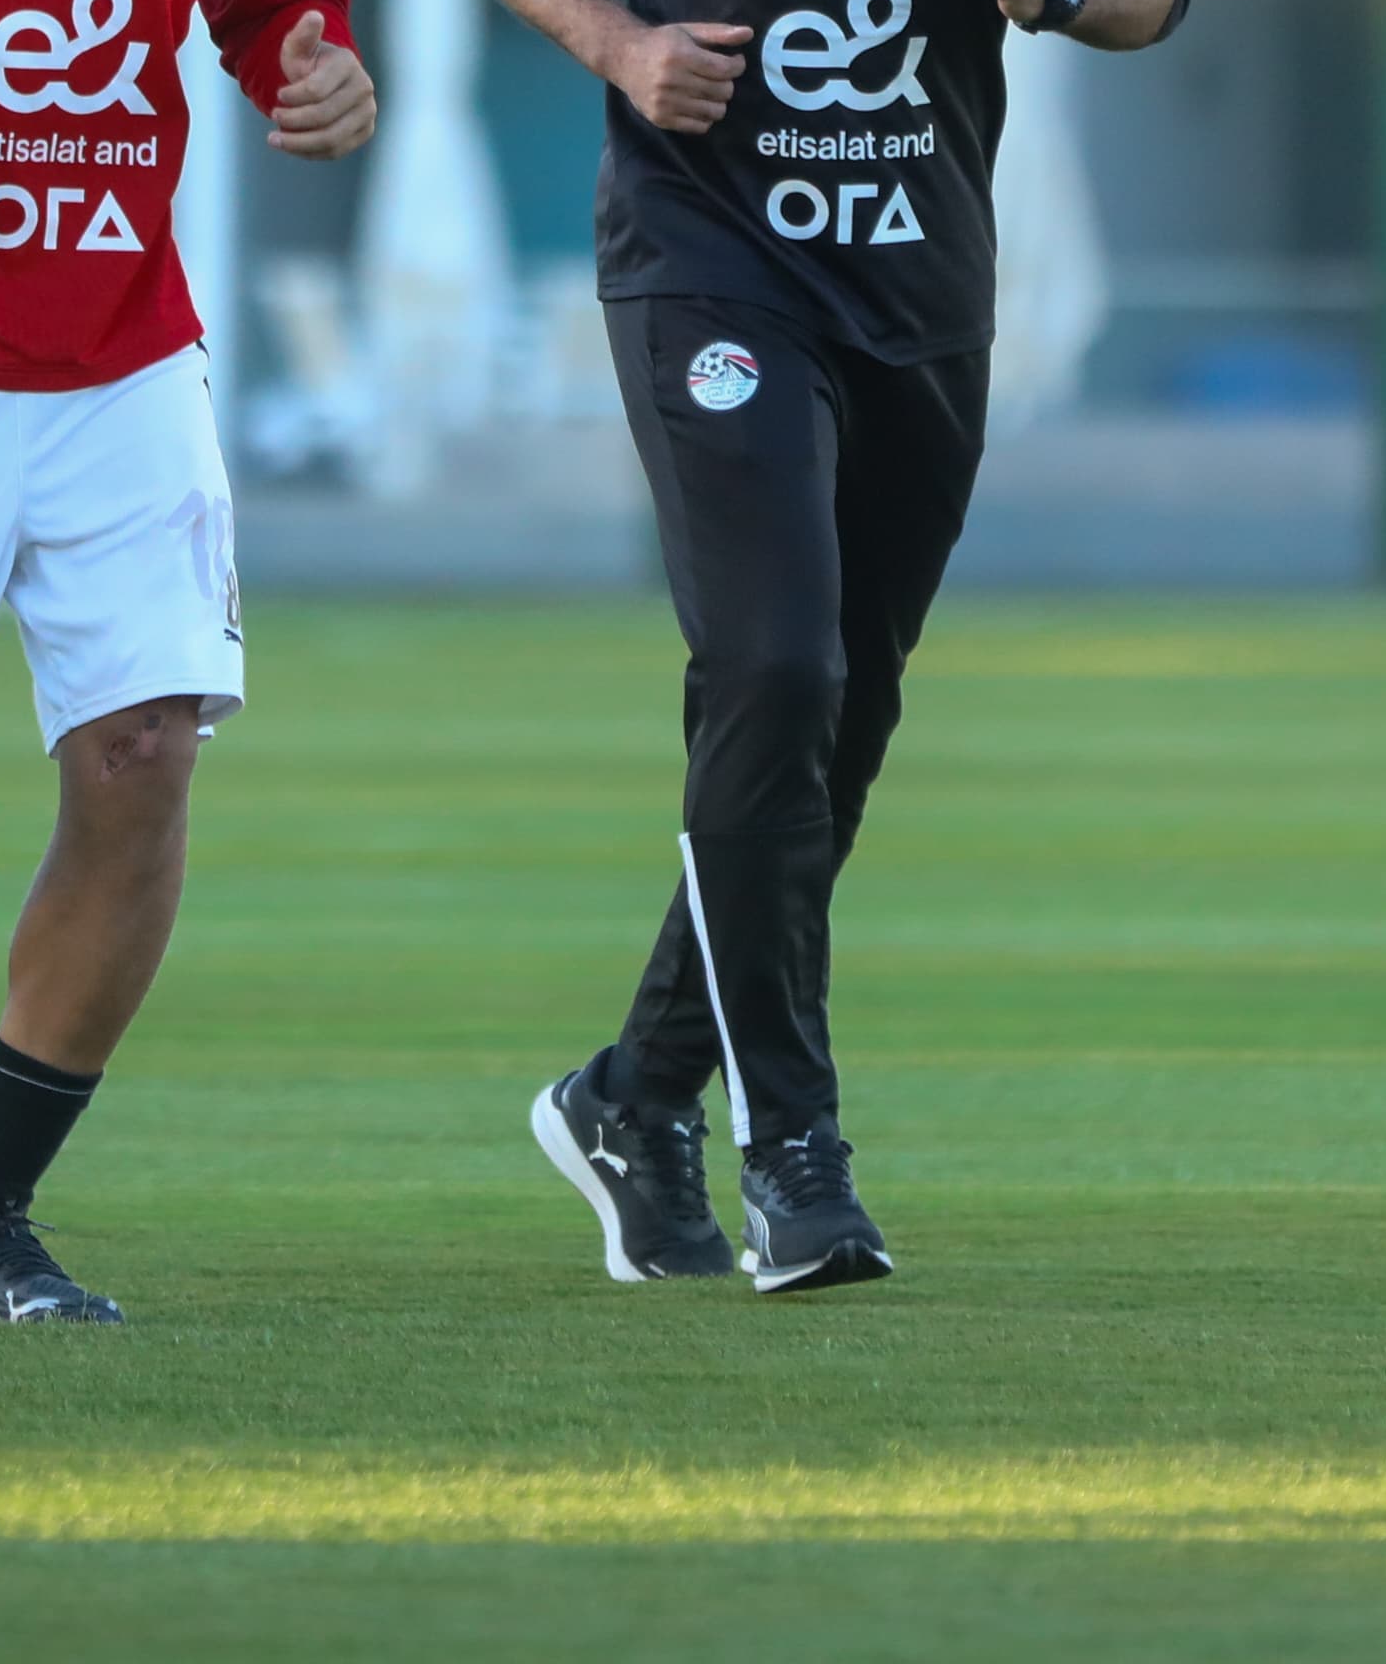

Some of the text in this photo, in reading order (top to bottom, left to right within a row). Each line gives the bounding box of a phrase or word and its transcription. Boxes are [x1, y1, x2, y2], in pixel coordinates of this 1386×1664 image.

[94, 135, 158, 167] and
[756, 124, 935, 161] etisalat and
